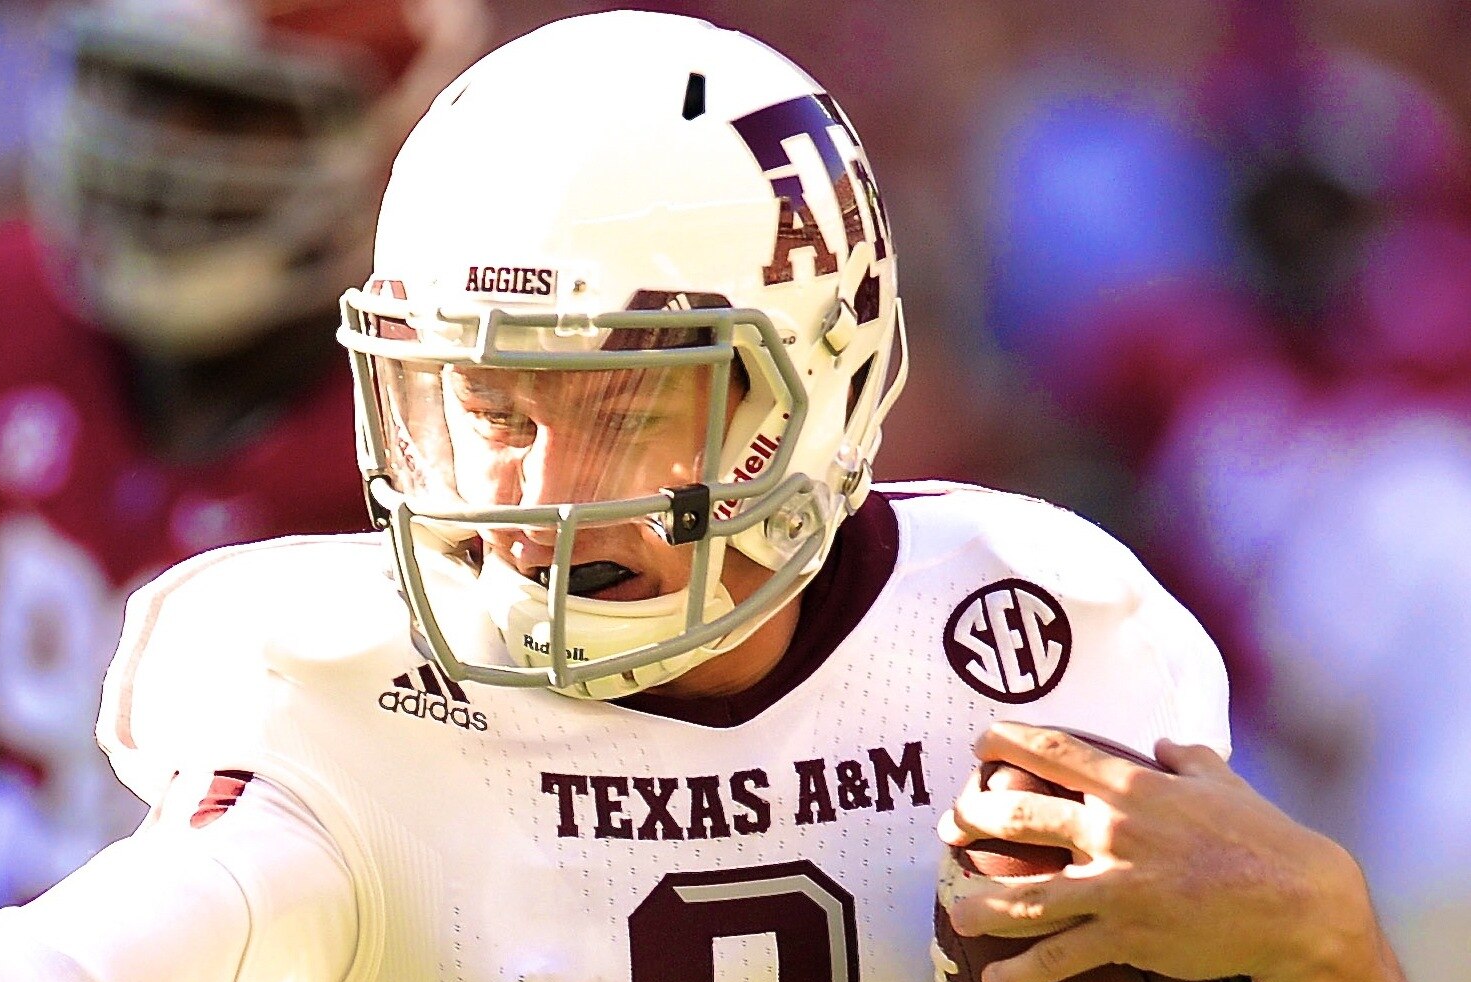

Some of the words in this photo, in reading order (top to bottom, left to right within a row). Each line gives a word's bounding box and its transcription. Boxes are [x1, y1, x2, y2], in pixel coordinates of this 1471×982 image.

[465, 266, 552, 296] AGGIES
[953, 587, 1063, 694] SEC
[378, 690, 488, 732] adidas
[540, 767, 772, 841] TEXAS
[793, 741, 932, 827] A&M
